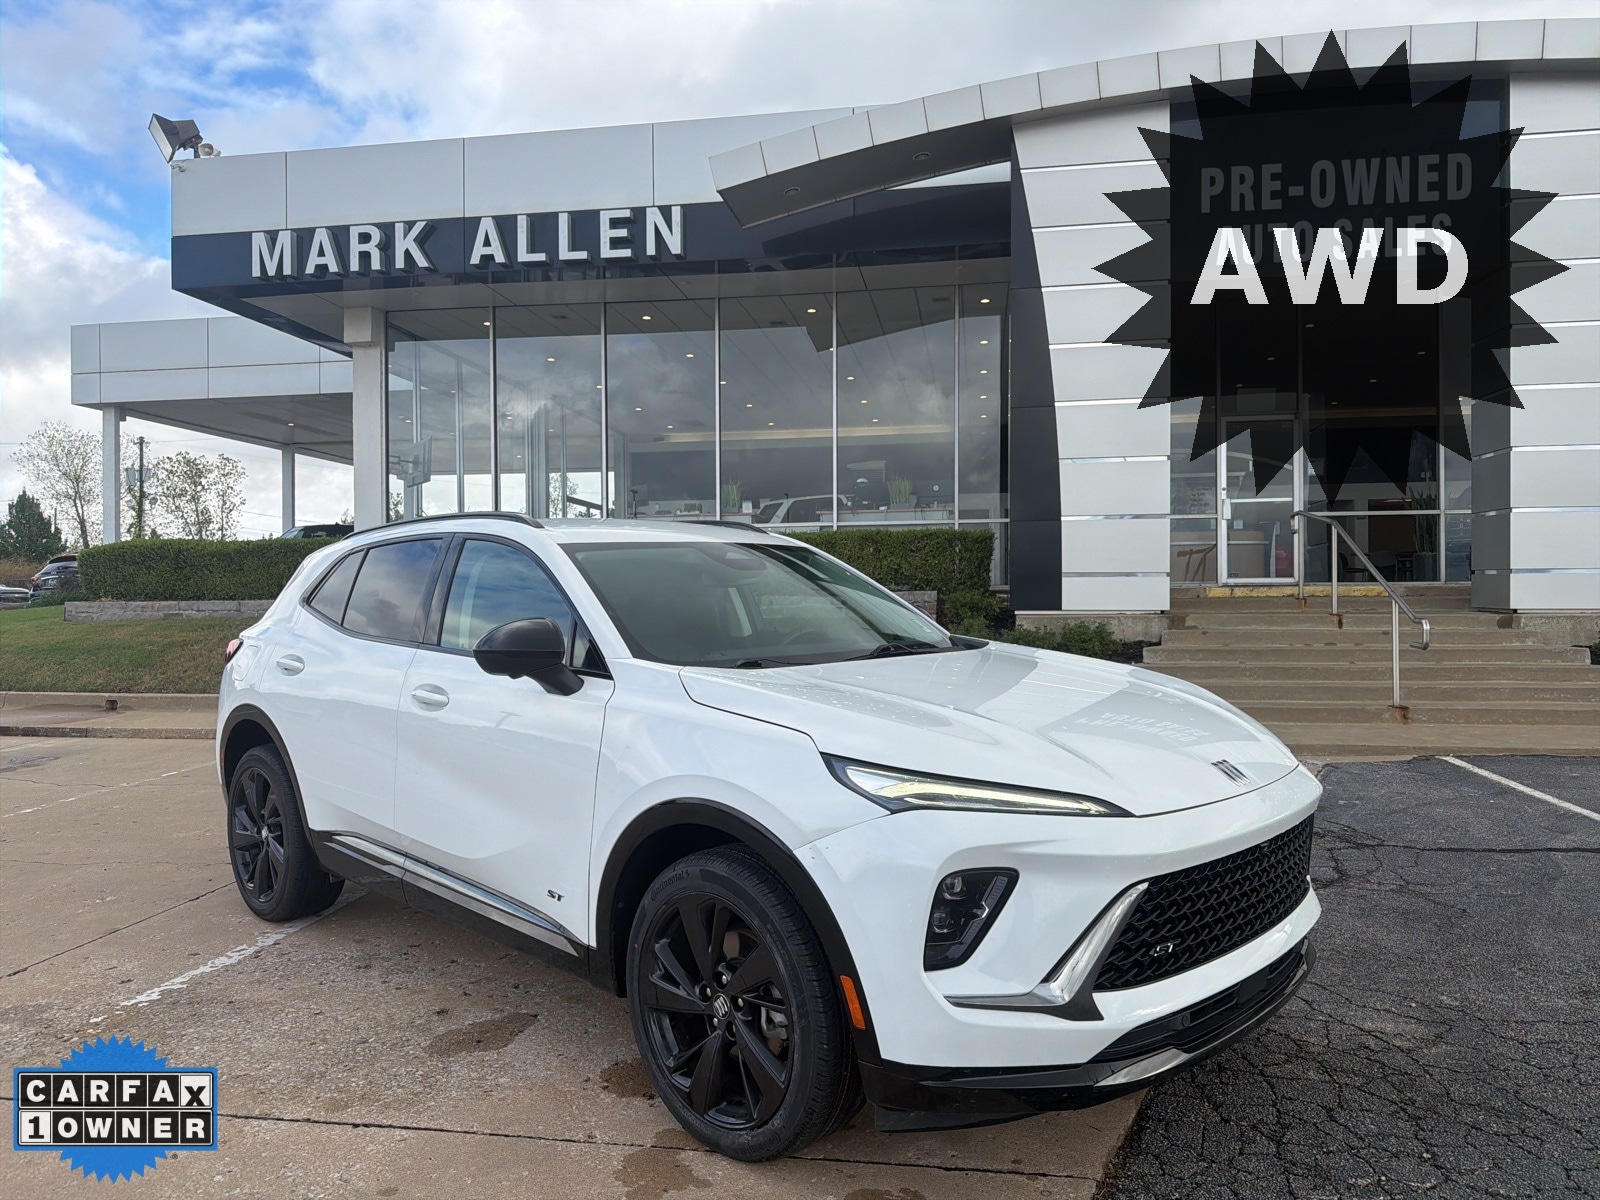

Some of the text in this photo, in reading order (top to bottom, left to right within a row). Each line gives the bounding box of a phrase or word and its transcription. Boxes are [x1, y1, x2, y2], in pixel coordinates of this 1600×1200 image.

[1200, 152, 1473, 214] PRE-OWNED
[251, 205, 683, 278] MARK ALLEN
[1215, 212, 1453, 267] AUTO SALES
[546, 889, 565, 902] ST
